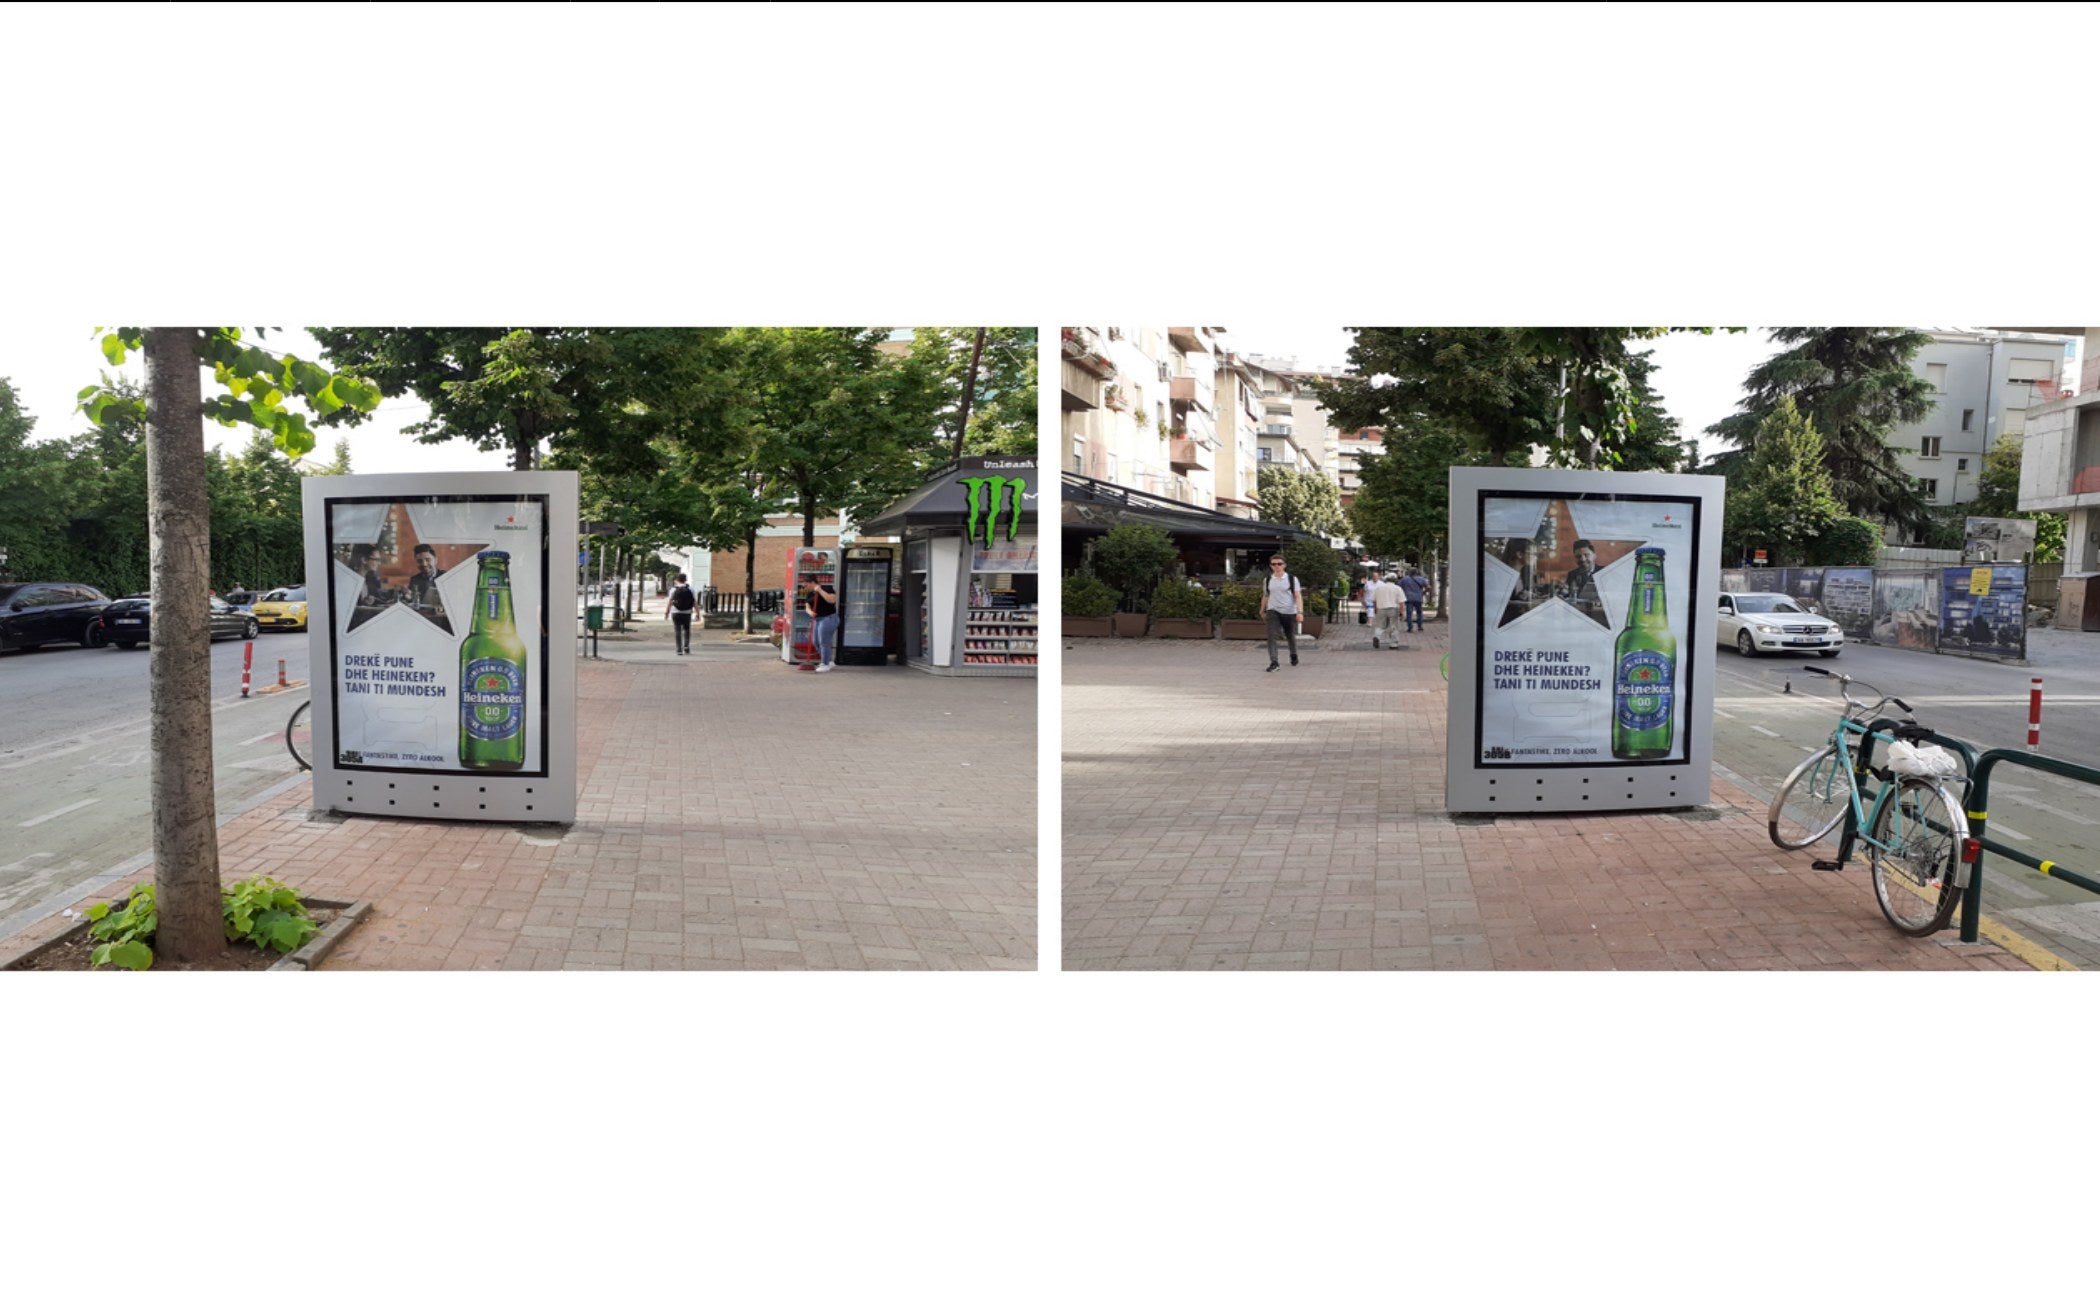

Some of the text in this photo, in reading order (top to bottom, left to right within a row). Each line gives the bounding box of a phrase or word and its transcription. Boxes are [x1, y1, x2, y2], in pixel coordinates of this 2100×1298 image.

[983, 460, 1035, 469] Unleash
[345, 653, 414, 668] DREKË PUNE
[1537, 651, 1570, 662] PUNE
[345, 669, 435, 682] DHE HEINEKEN?
[1494, 664, 1591, 676] DHE HEINEKEN?
[345, 682, 446, 697] TANI TI MUNDESH
[1494, 678, 1601, 690] TANI TI MUNDESH
[1617, 684, 1671, 695] Heineken
[463, 692, 522, 703] Heineken
